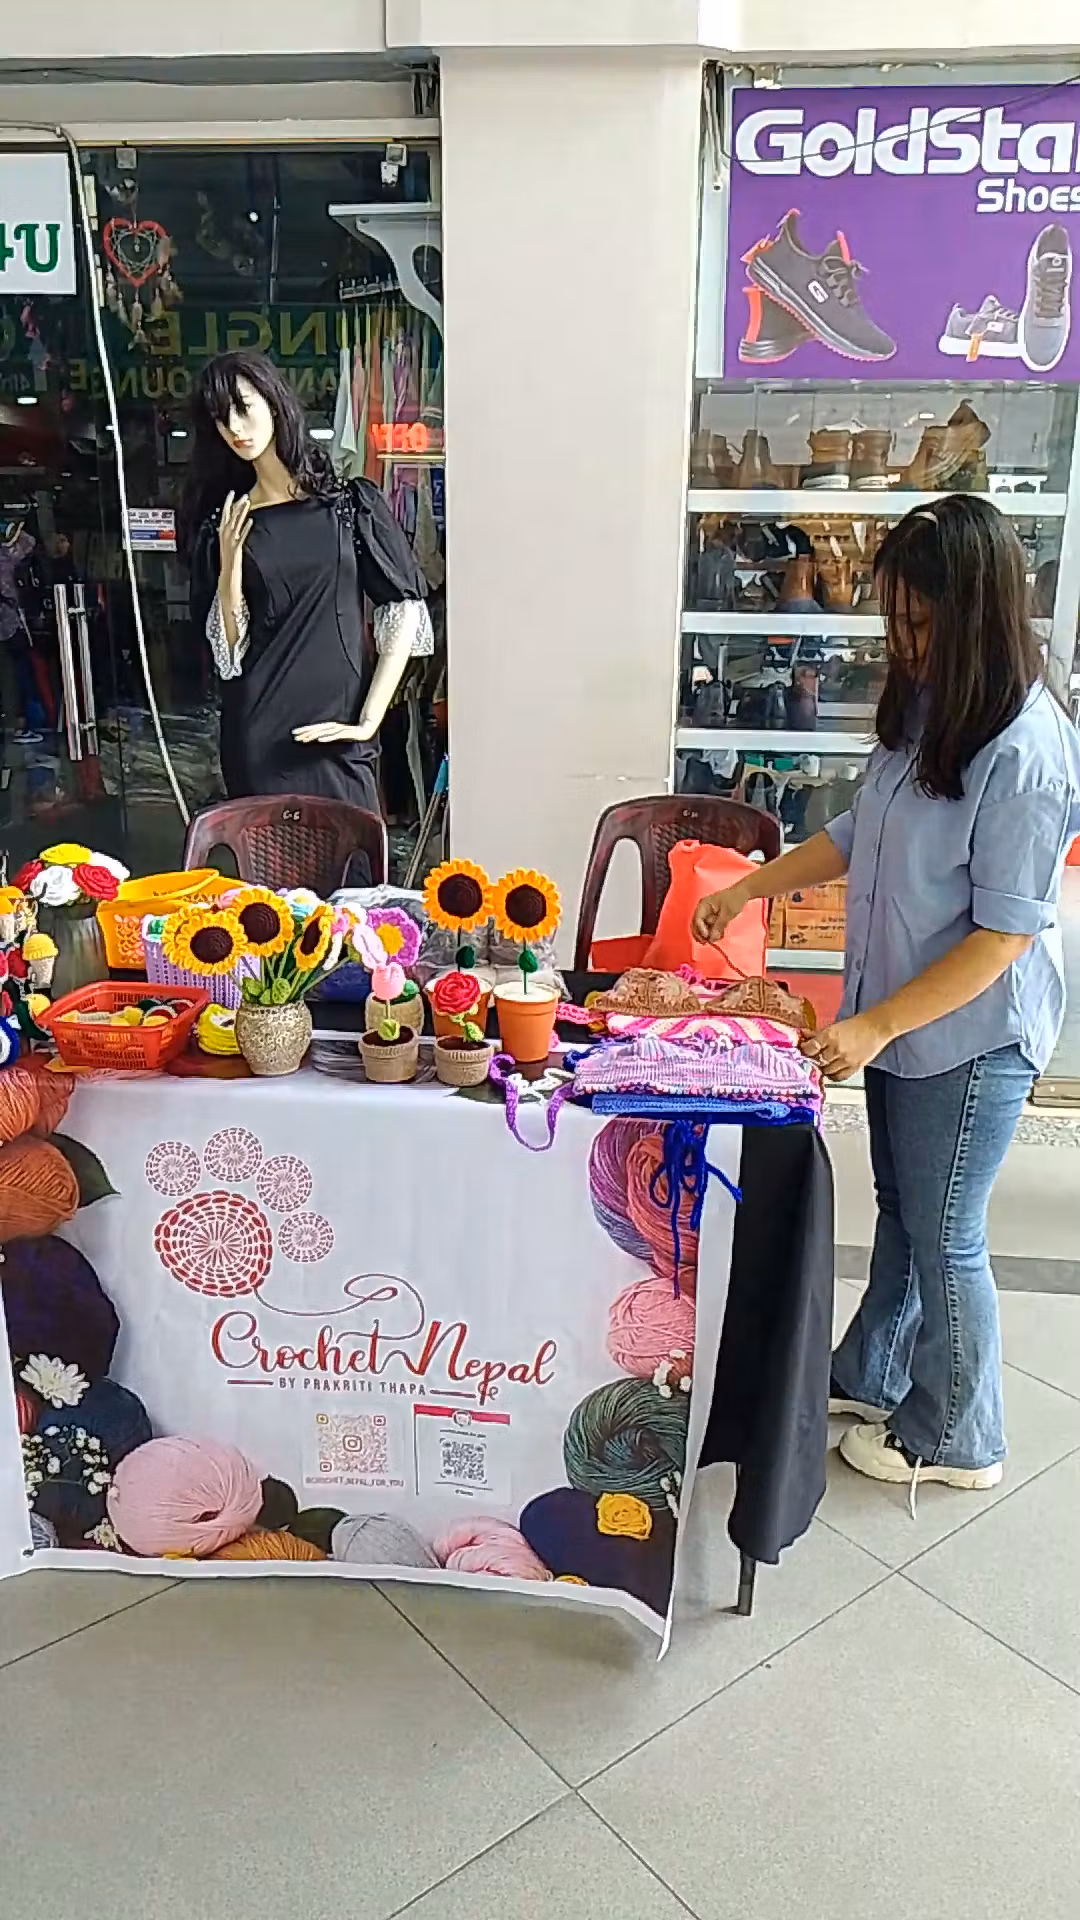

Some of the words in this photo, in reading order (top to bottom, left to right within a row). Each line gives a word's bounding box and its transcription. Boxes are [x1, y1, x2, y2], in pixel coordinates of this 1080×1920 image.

[976, 178, 1080, 213] Shoes
[211, 1311, 384, 1375] Crochet
[410, 1320, 558, 1406] Nepal
[278, 1376, 296, 1389] BY
[303, 1378, 373, 1393] PRAKRITI
[379, 1381, 426, 1396] THAPA
